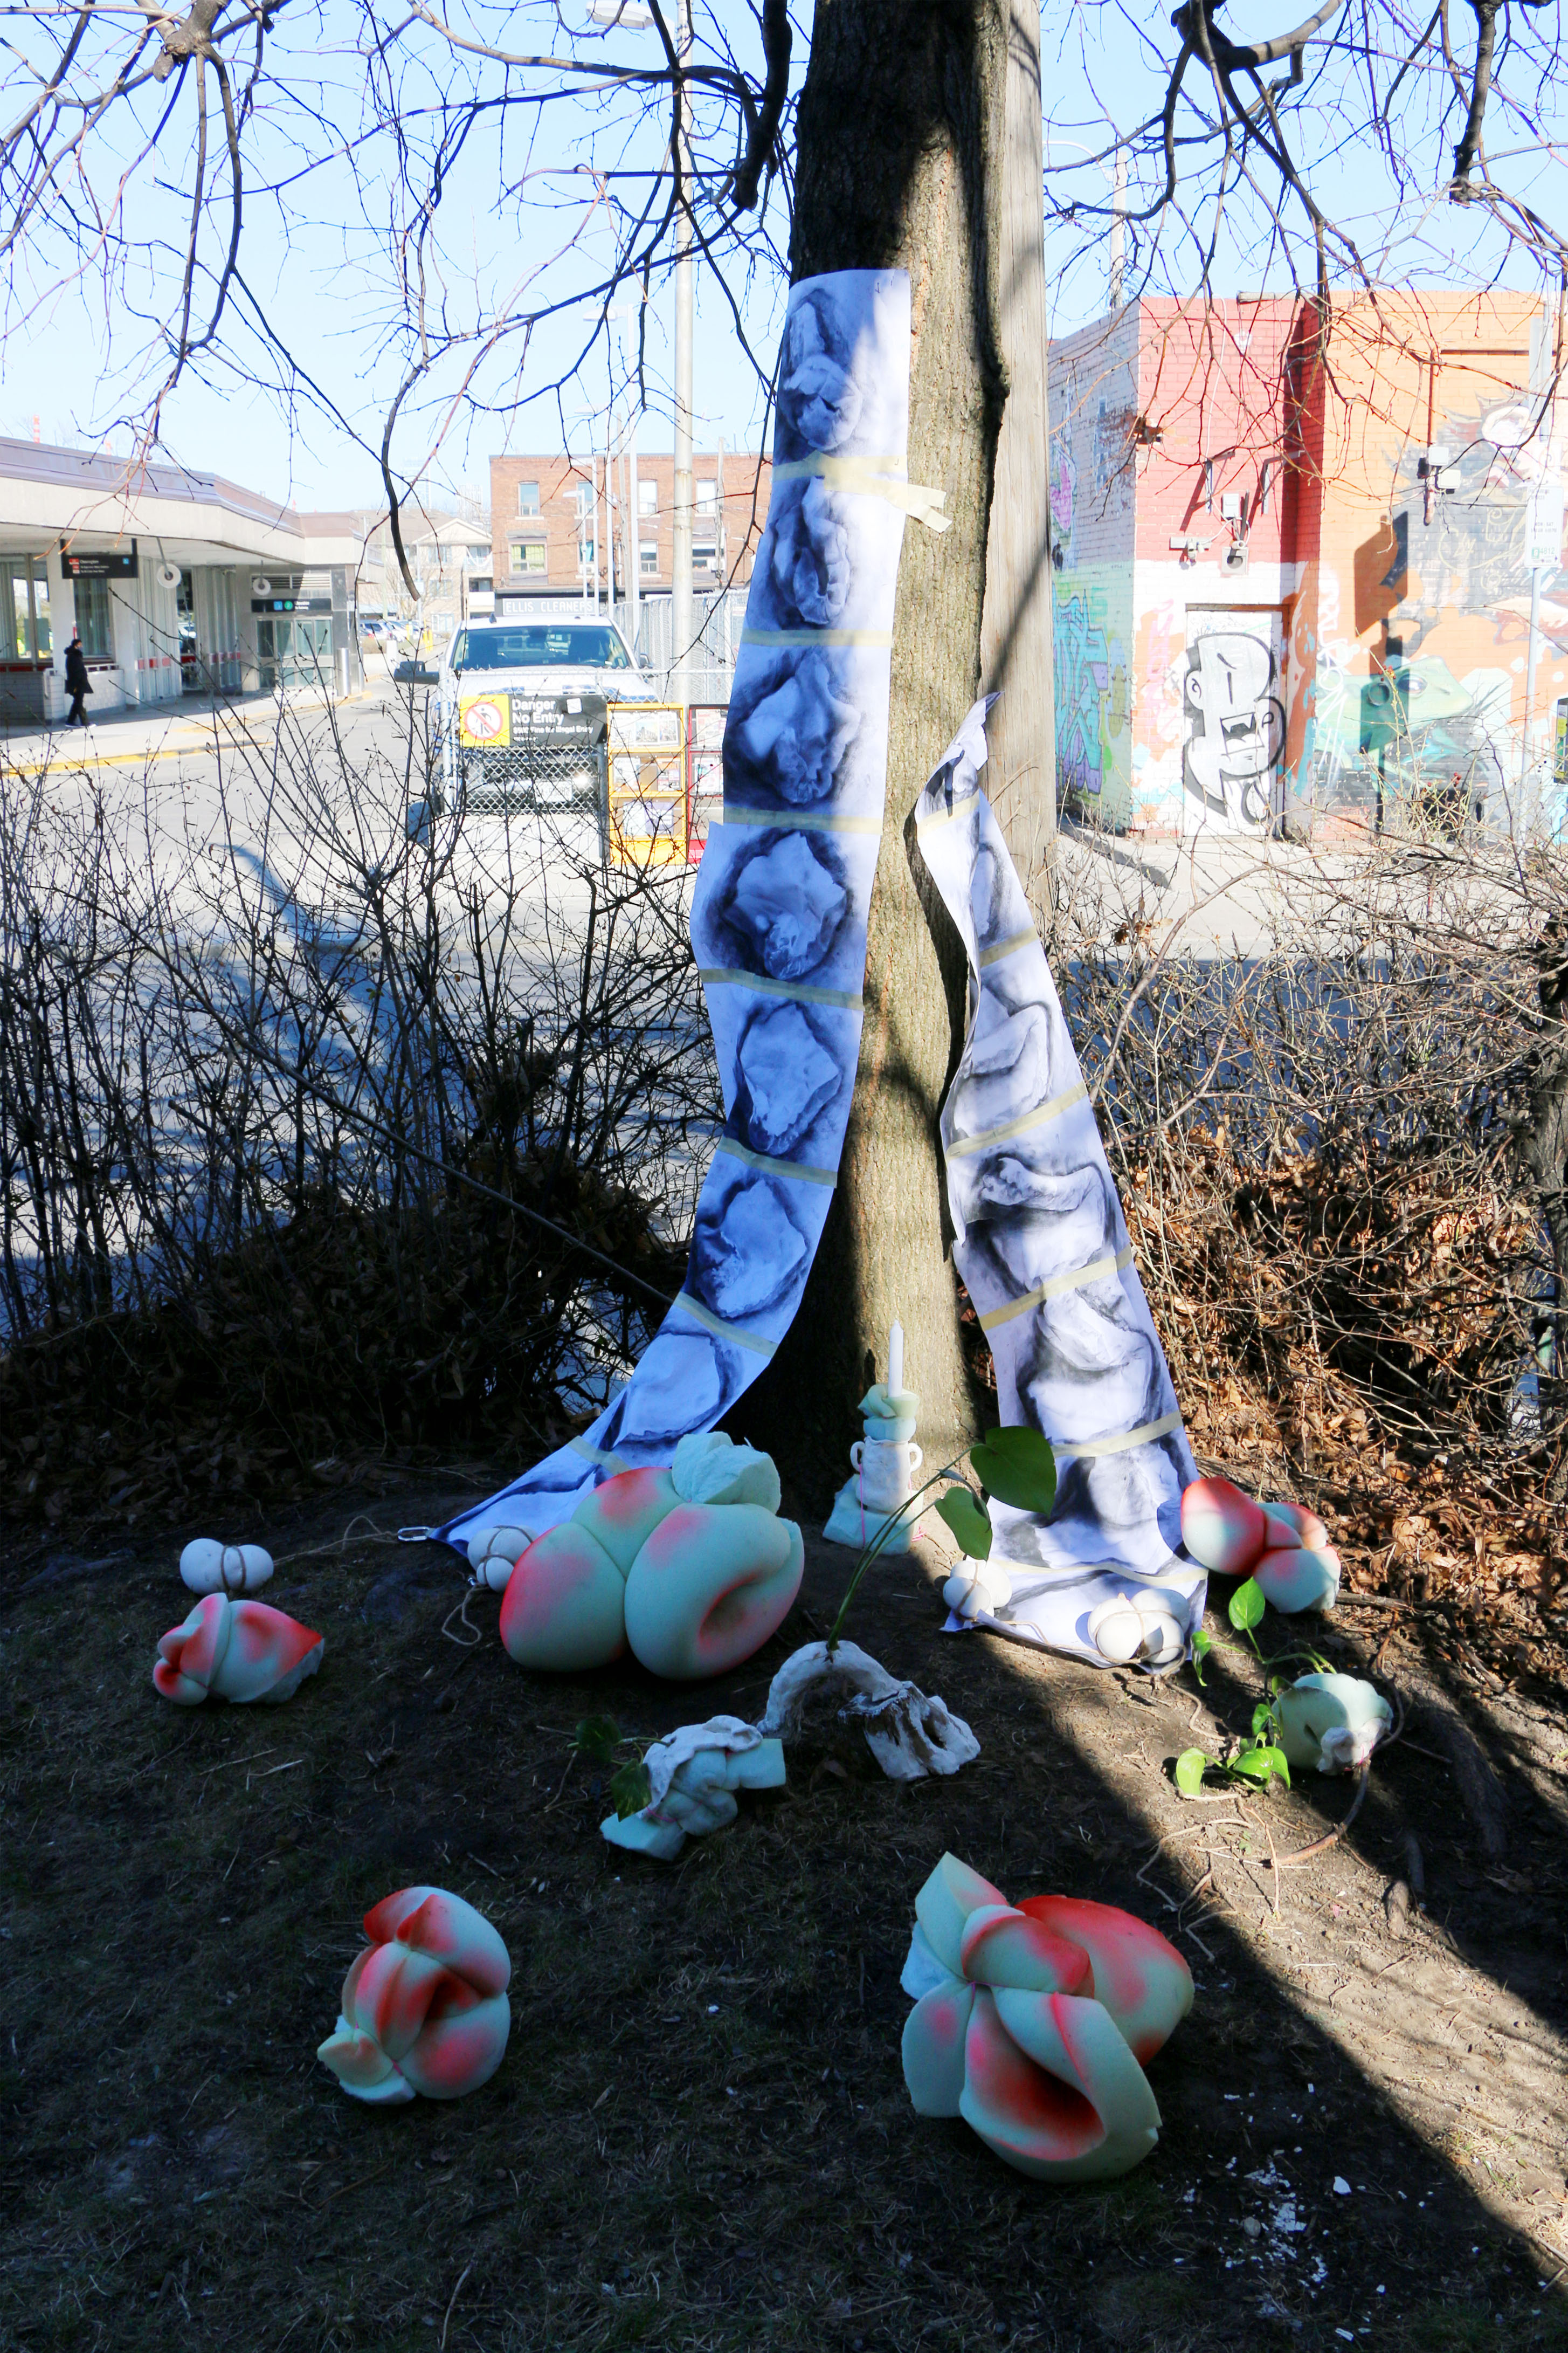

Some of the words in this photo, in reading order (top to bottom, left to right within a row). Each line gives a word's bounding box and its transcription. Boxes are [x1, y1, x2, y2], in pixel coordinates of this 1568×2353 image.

[506, 601, 534, 613] ELLIS
[541, 601, 593, 613] CLEANERS
[512, 699, 556, 712] Danger
[512, 712, 530, 724] No
[533, 712, 564, 725] Entry
[556, 725, 575, 734] Illegal
